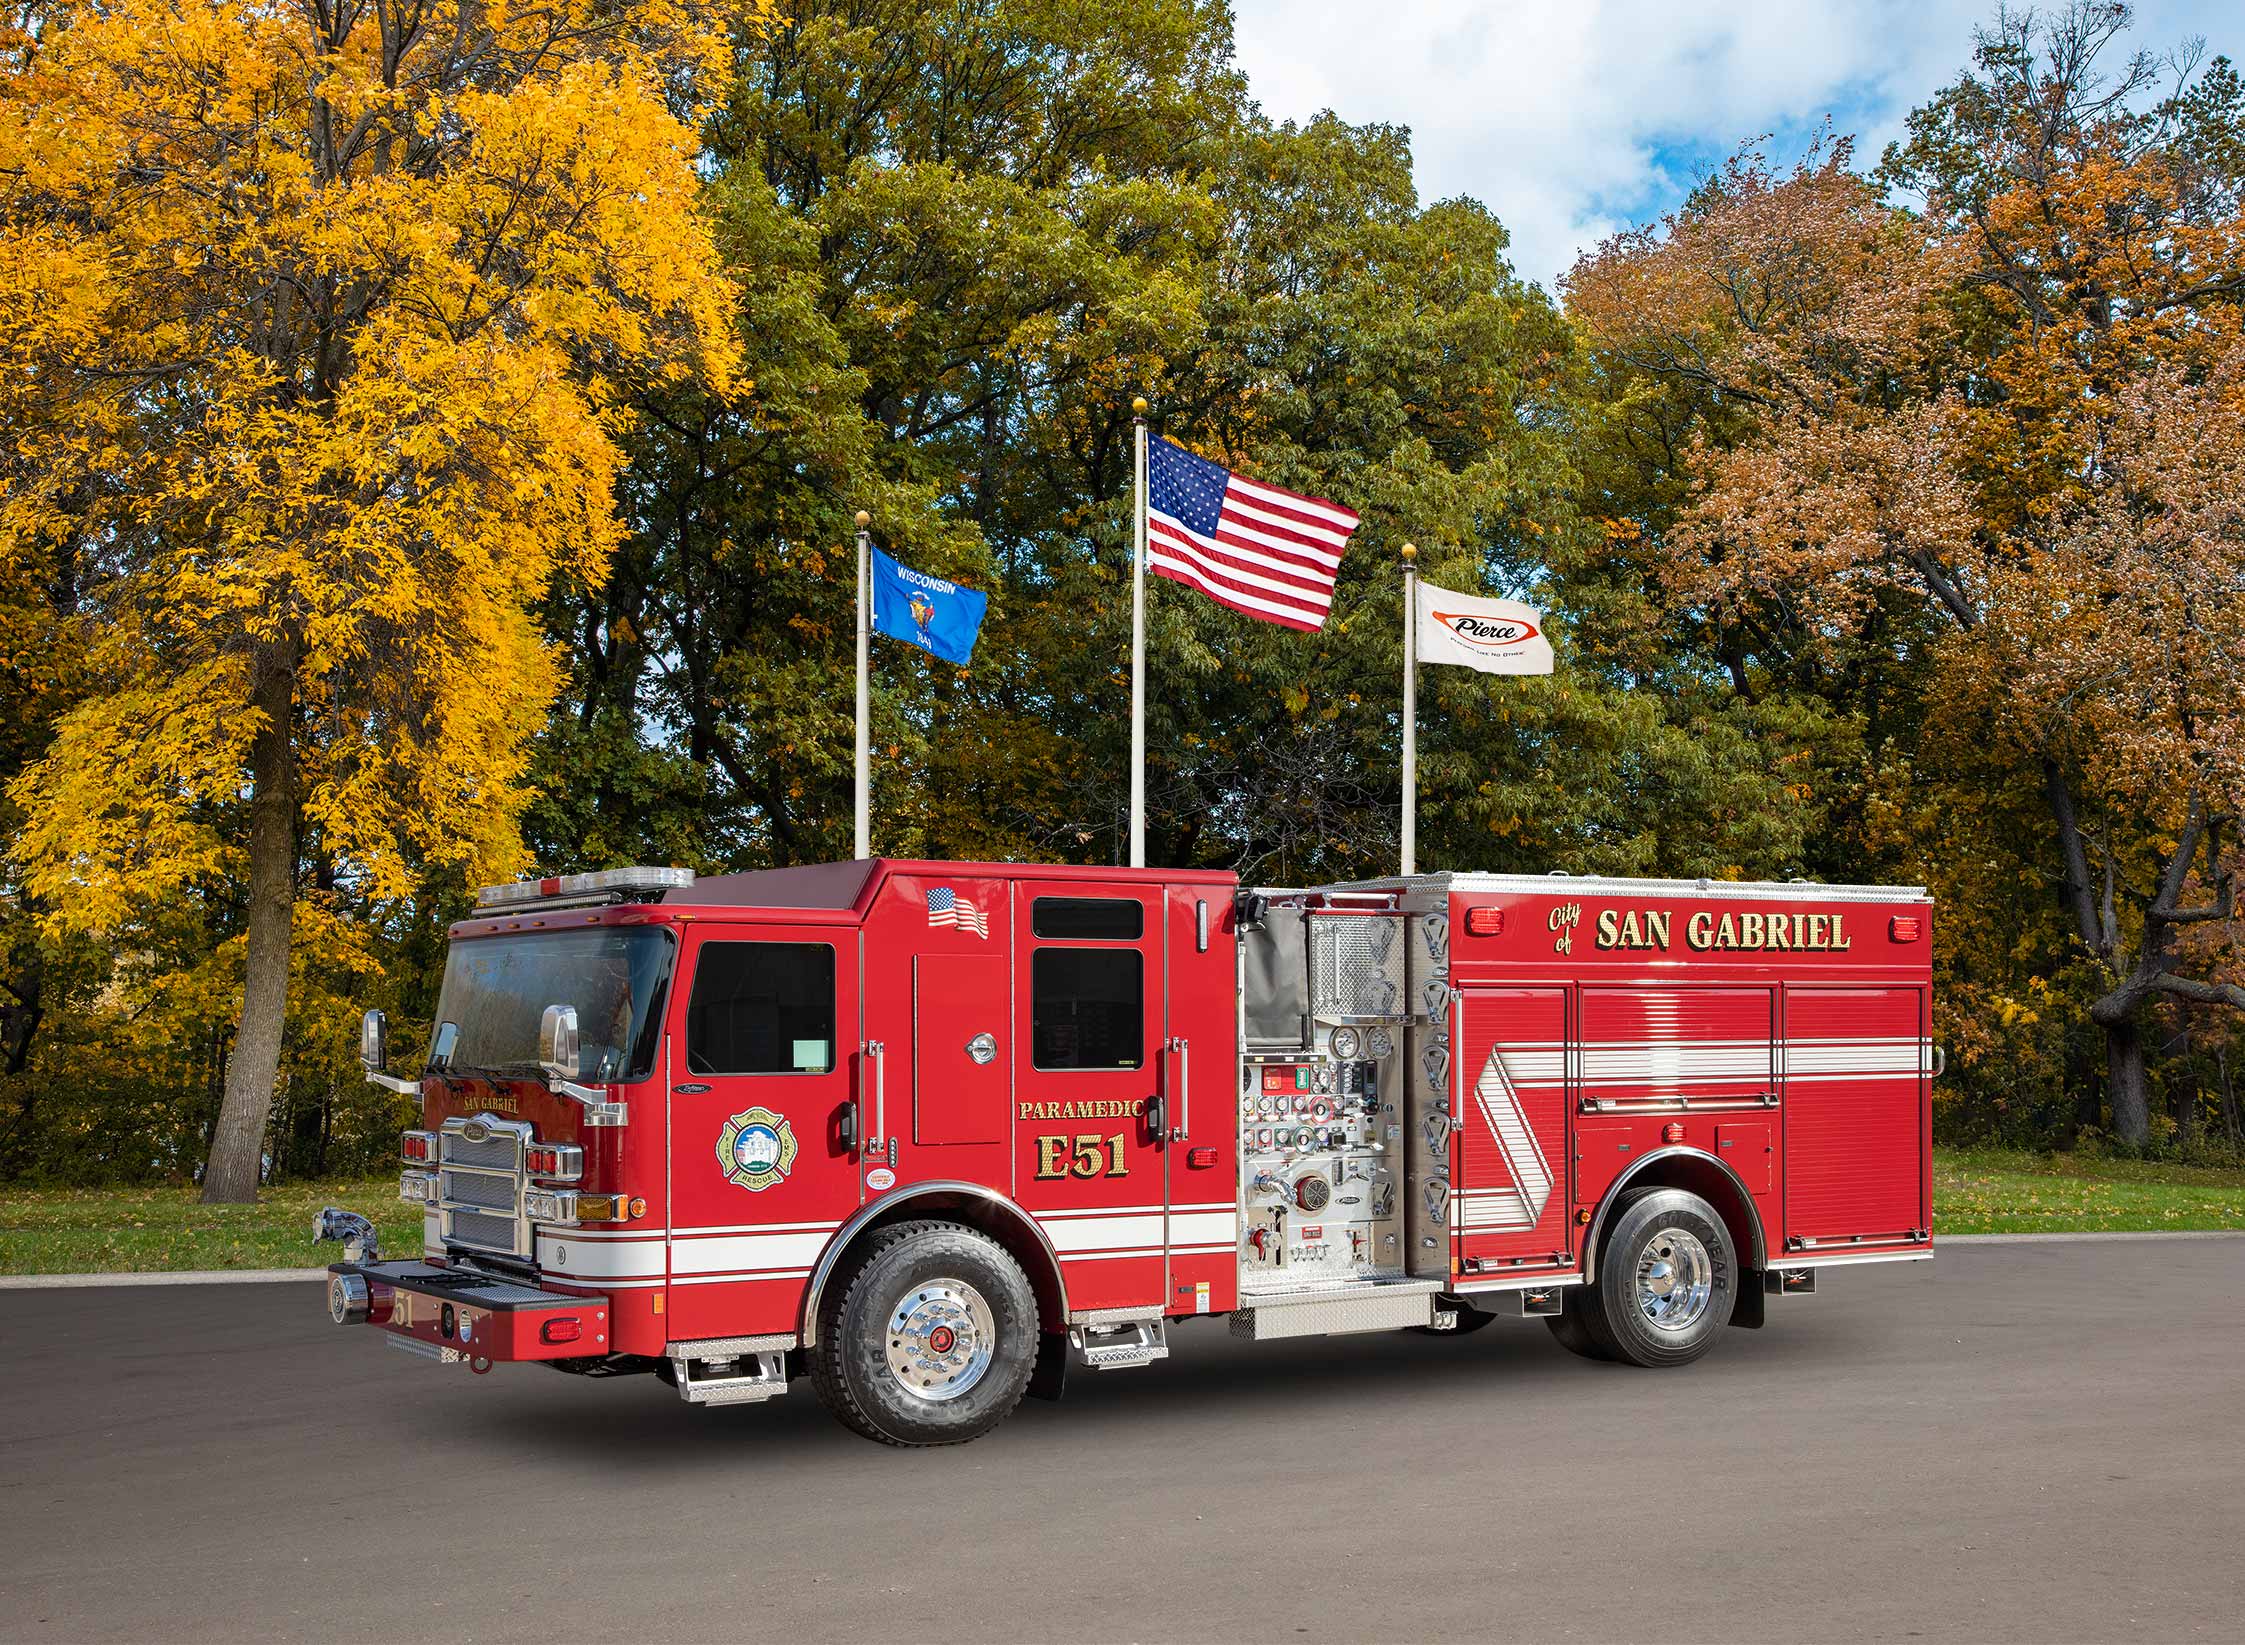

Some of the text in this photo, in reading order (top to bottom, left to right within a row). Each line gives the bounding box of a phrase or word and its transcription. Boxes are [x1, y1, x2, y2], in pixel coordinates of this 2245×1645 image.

[897, 566, 956, 595] WISCONSIN
[1455, 618, 1516, 638] Pierce
[1548, 902, 1582, 932] City
[1596, 910, 1852, 952] SAN GABRIEL
[1554, 926, 1573, 955] of
[464, 1097, 519, 1114] SAN GABRIEL
[1019, 1100, 1145, 1120] PARAMEDIC
[1034, 1132, 1130, 1180] E51
[742, 1174, 773, 1184] RESCUE
[394, 1290, 414, 1328] 51
